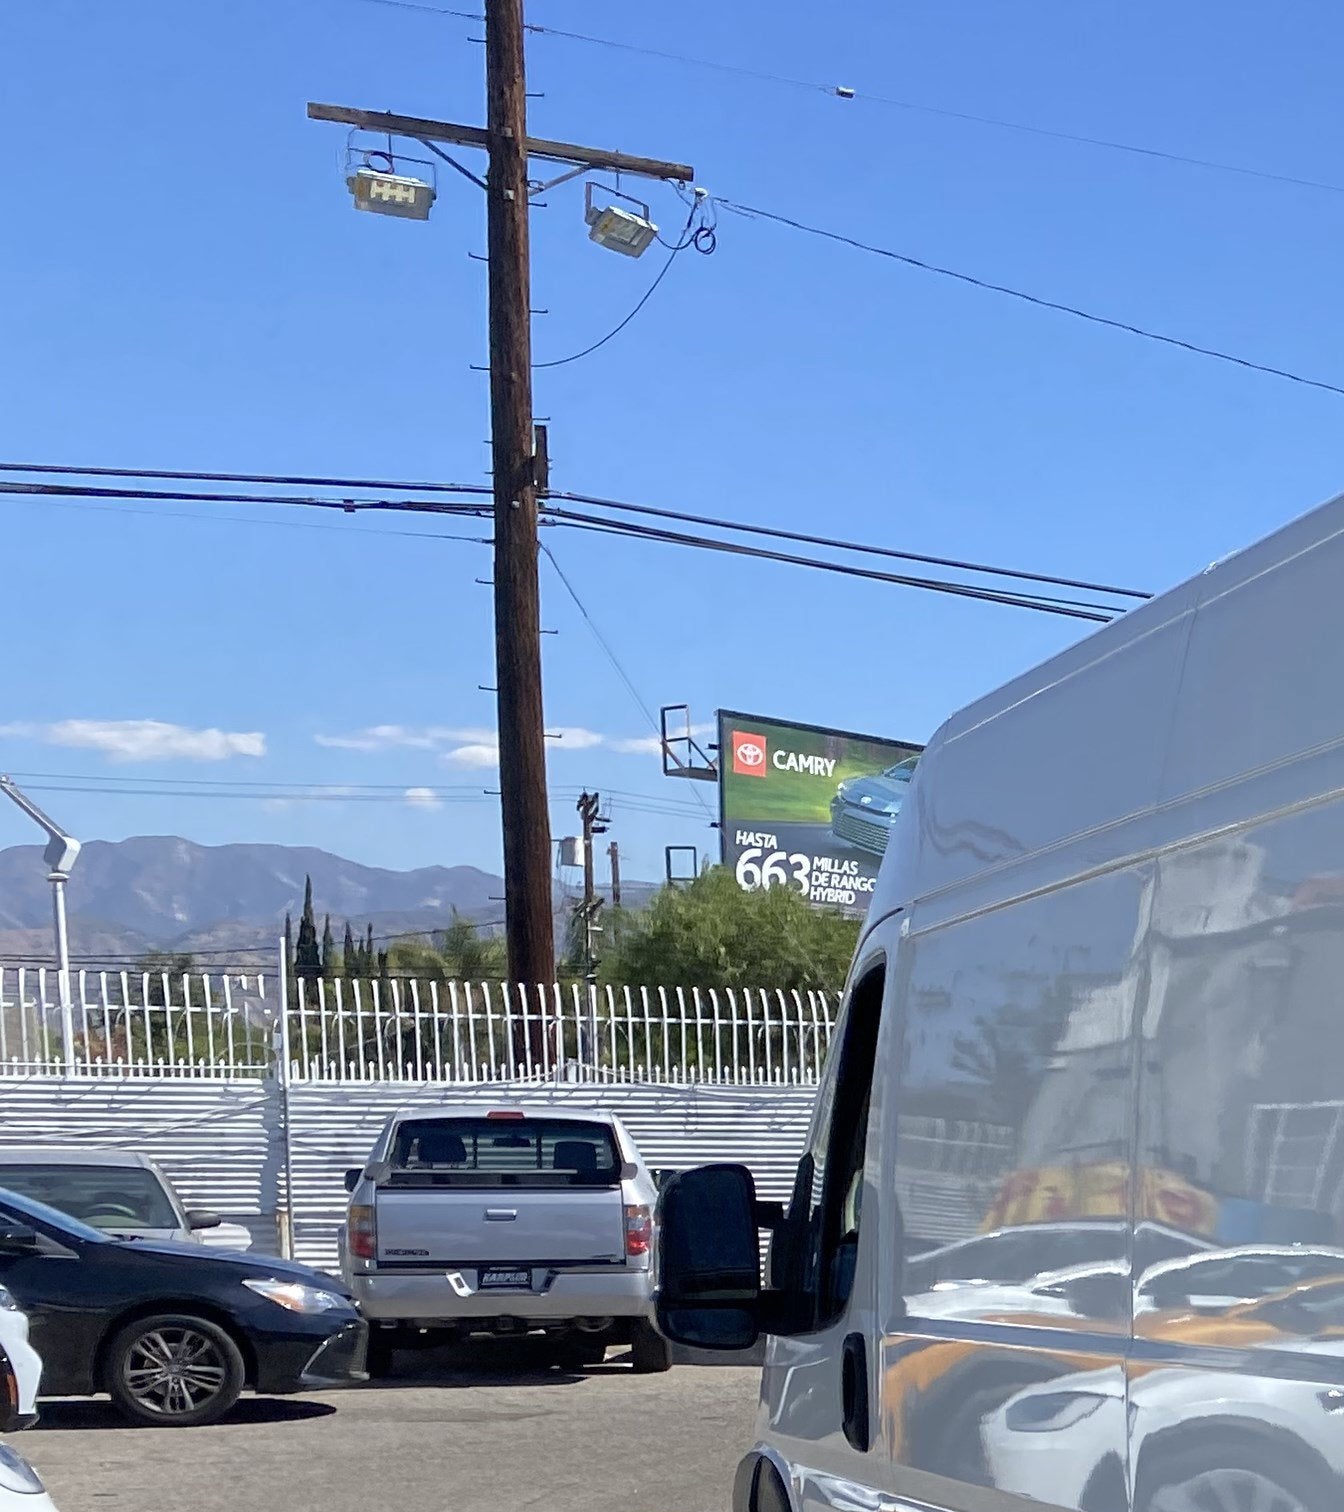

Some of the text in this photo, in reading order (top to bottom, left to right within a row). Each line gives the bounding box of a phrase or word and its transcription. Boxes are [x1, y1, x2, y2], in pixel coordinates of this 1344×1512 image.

[772, 750, 836, 777] CAMRY
[735, 830, 778, 849] HASTA
[735, 848, 811, 897] 663
[812, 856, 859, 875] MILLAS
[811, 871, 829, 886] DE
[809, 886, 856, 905] HYBRID
